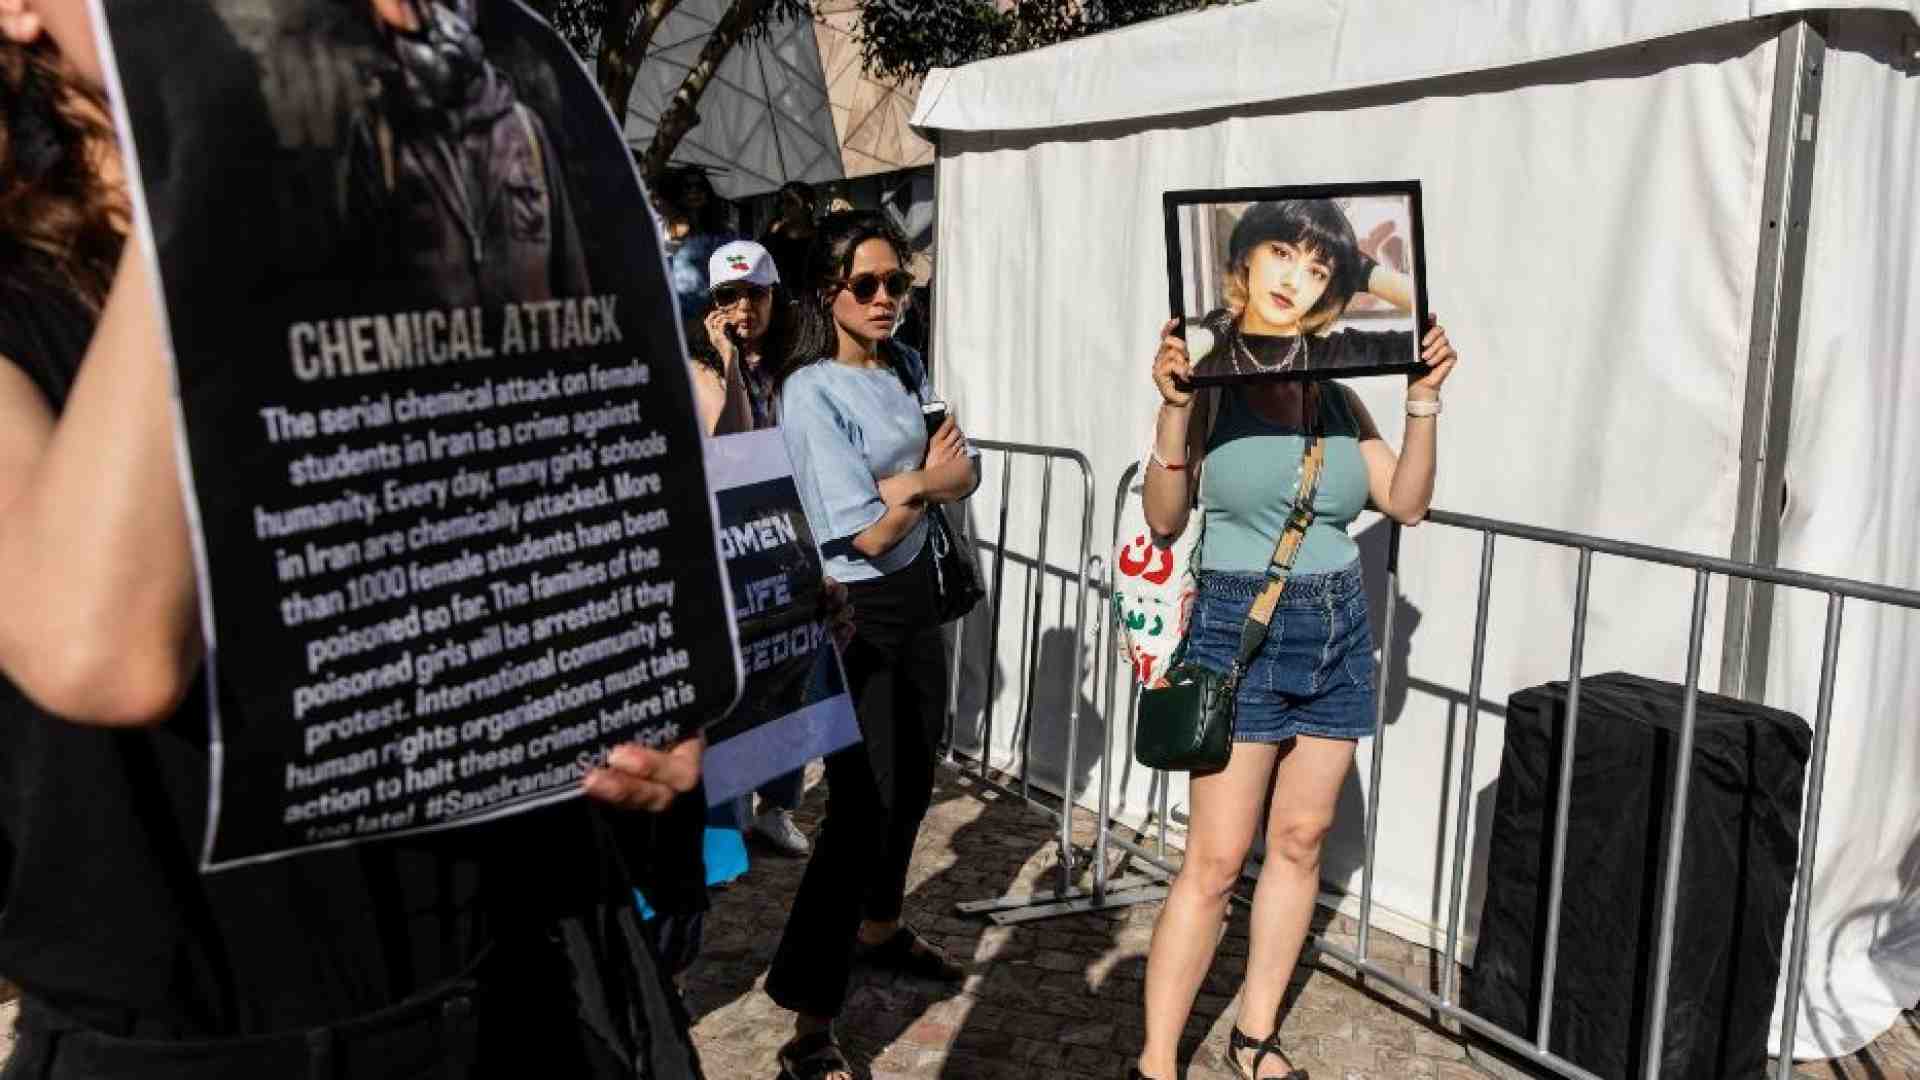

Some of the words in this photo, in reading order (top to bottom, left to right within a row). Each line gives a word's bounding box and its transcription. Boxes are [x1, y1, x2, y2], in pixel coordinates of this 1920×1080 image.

[288, 306, 494, 381] CHEMICAL
[502, 294, 622, 357] ATTACK
[260, 406, 317, 443] The
[320, 393, 393, 435] serial
[395, 378, 494, 422] chemical
[496, 369, 560, 406] attack
[562, 372, 588, 397] on
[590, 358, 649, 391] female
[288, 443, 401, 486] students
[403, 433, 427, 464] in
[429, 429, 475, 461] Iran
[477, 421, 496, 450] is
[499, 424, 512, 447] a
[514, 411, 569, 445] crime
[573, 399, 640, 439] against
[255, 489, 382, 540] humanity.
[383, 479, 448, 512] Every
[496, 459, 547, 488] many
[600, 431, 667, 466] schools
[276, 548, 304, 581] in
[305, 541, 361, 576] Iran
[364, 530, 404, 561] are
[408, 500, 520, 550] chemically
[522, 478, 613, 523] attacked.
[614, 472, 661, 500] More
[718, 511, 797, 560] OMEN
[281, 592, 344, 626] than
[347, 565, 407, 611] 1000
[409, 549, 484, 592] female
[487, 530, 576, 572] students
[576, 521, 622, 548] have
[623, 508, 669, 537] been
[307, 604, 421, 674] poisoned
[422, 605, 450, 633] so
[451, 593, 489, 622] far.
[490, 582, 529, 610] The
[531, 562, 607, 600] families
[608, 548, 626, 580] of
[629, 545, 660, 573] the
[293, 649, 413, 721] poisoned
[415, 638, 467, 686] girls
[468, 624, 503, 661] will
[503, 620, 530, 650] be
[532, 590, 620, 642] arrested
[620, 584, 633, 614] if
[636, 580, 674, 608] they
[305, 697, 411, 756] protest.
[416, 646, 556, 717] International
[558, 620, 657, 673] community
[658, 611, 673, 639] &
[284, 786, 371, 823] action
[375, 776, 401, 801] to
[405, 758, 454, 794] halt
[459, 743, 525, 779] these
[528, 719, 598, 759] crimes
[600, 696, 662, 733] before
[662, 684, 678, 711] it
[678, 680, 695, 705] is
[285, 748, 377, 791] human
[381, 725, 458, 765] rights
[460, 678, 602, 742] organisations
[604, 659, 650, 697] must
[650, 646, 690, 679] take
